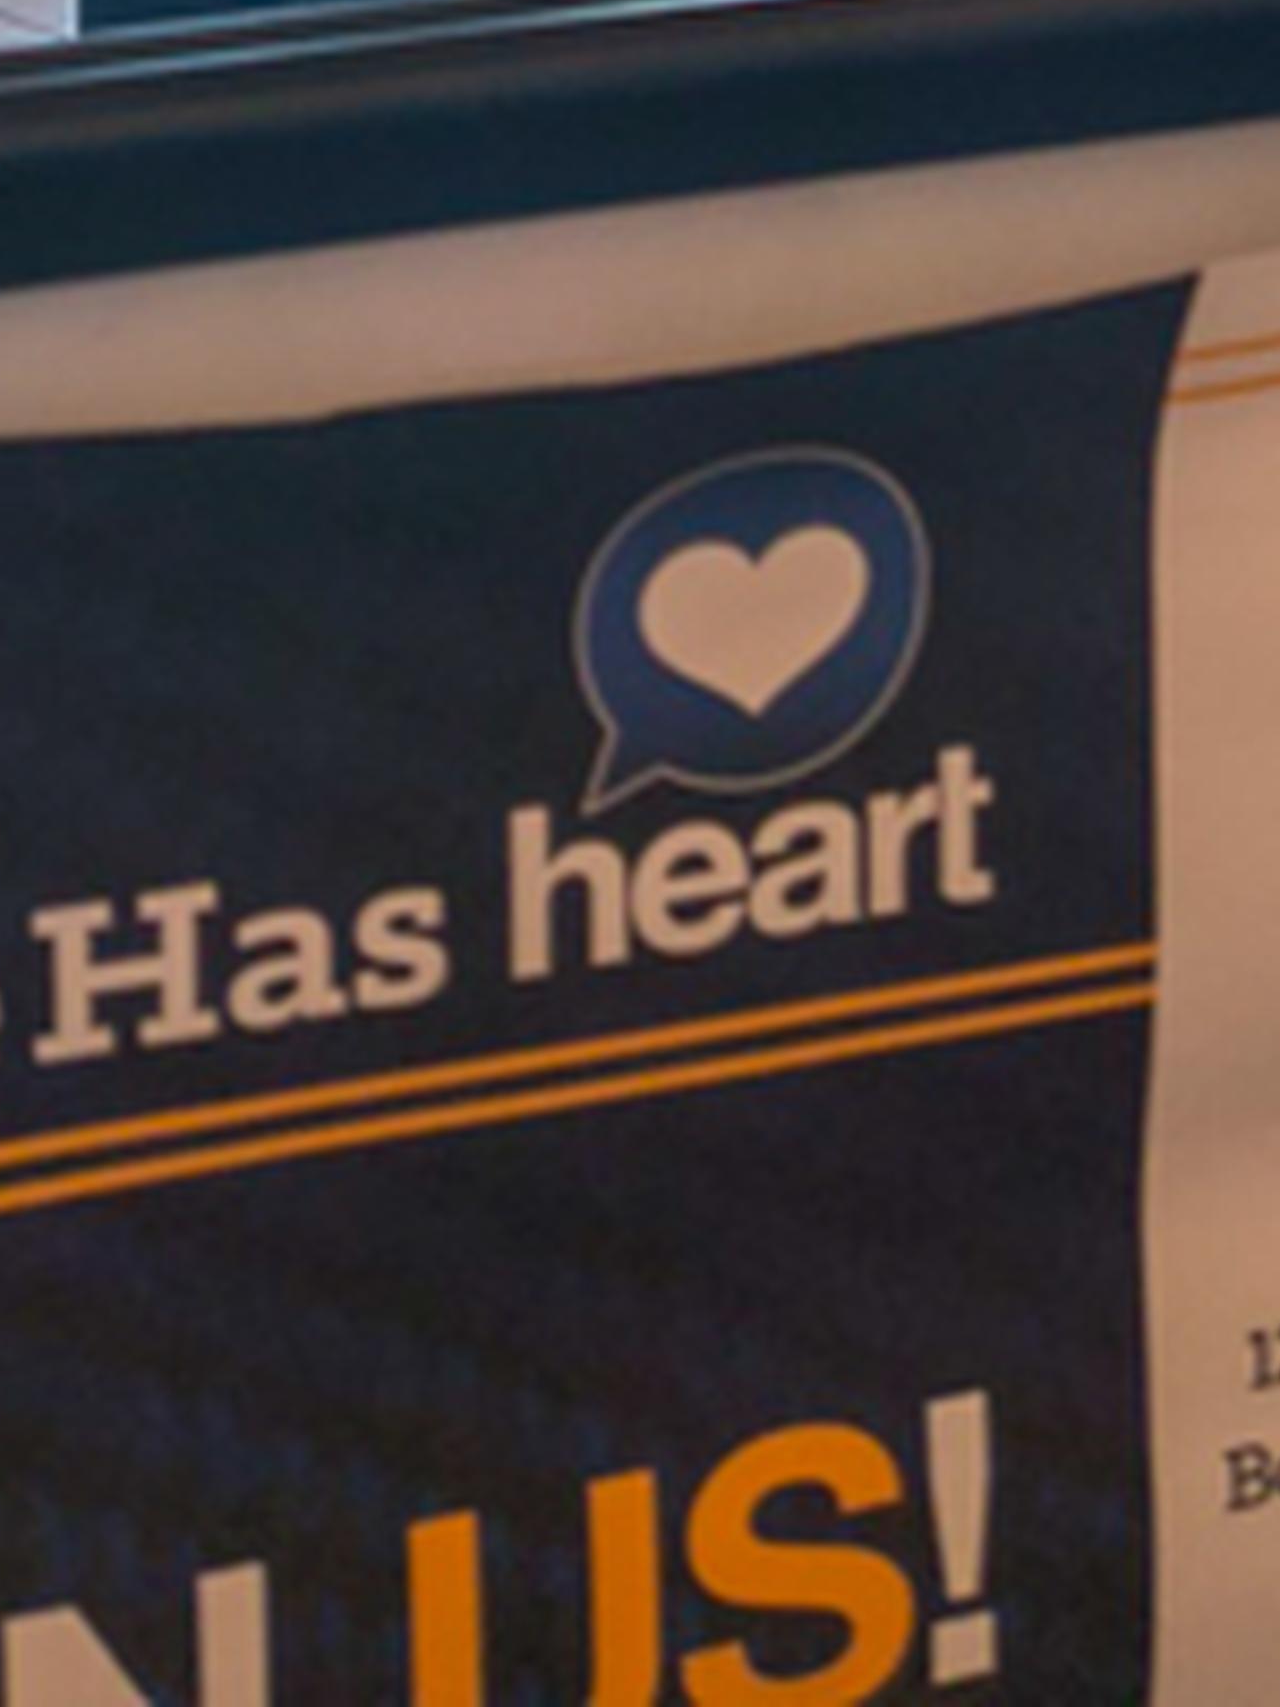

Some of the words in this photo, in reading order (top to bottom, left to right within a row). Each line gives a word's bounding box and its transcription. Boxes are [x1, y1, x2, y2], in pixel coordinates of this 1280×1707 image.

[30, 881, 448, 1064] Has
[508, 745, 994, 980] heart
[408, 1389, 996, 1707] US!
